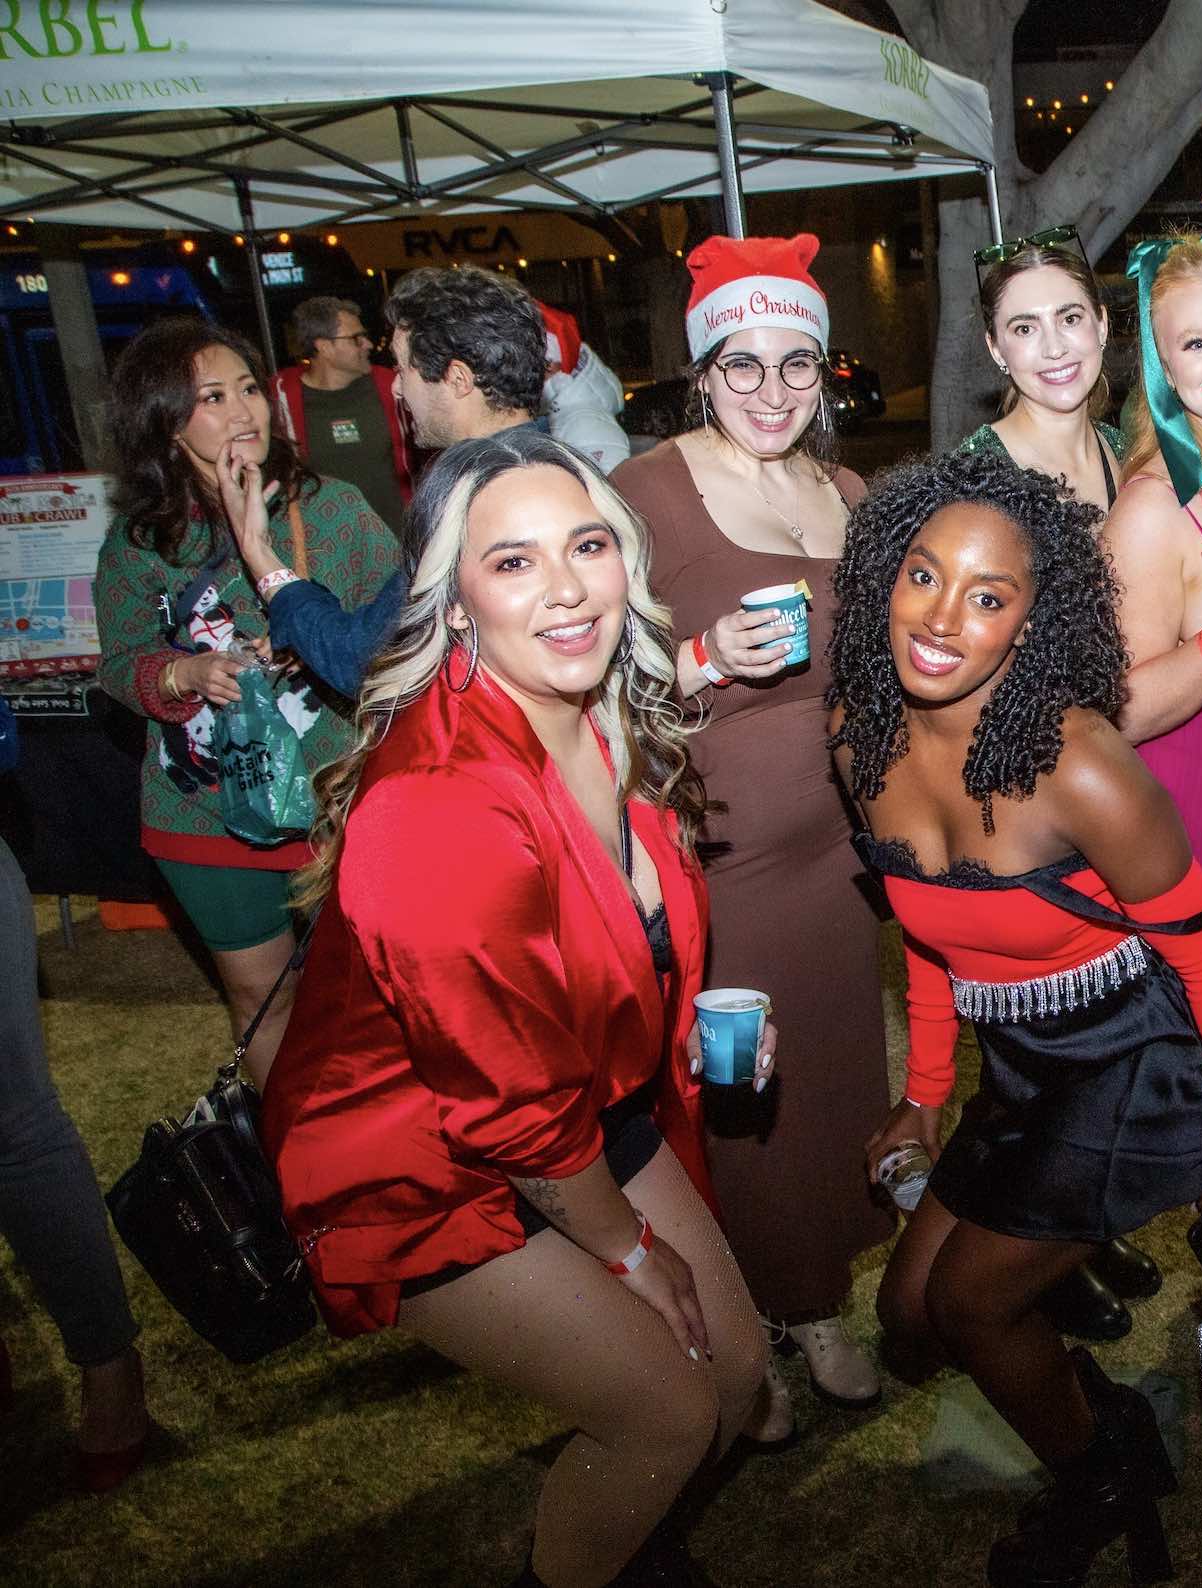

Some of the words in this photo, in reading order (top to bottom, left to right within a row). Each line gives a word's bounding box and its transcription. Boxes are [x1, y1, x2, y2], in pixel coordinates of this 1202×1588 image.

[880, 37, 930, 100] KORBEL
[403, 225, 522, 257] RVCA
[16, 274, 49, 293] 180
[703, 304, 746, 338] Merry
[0, 512, 22, 526] UB
[33, 508, 88, 523] CRAWL
